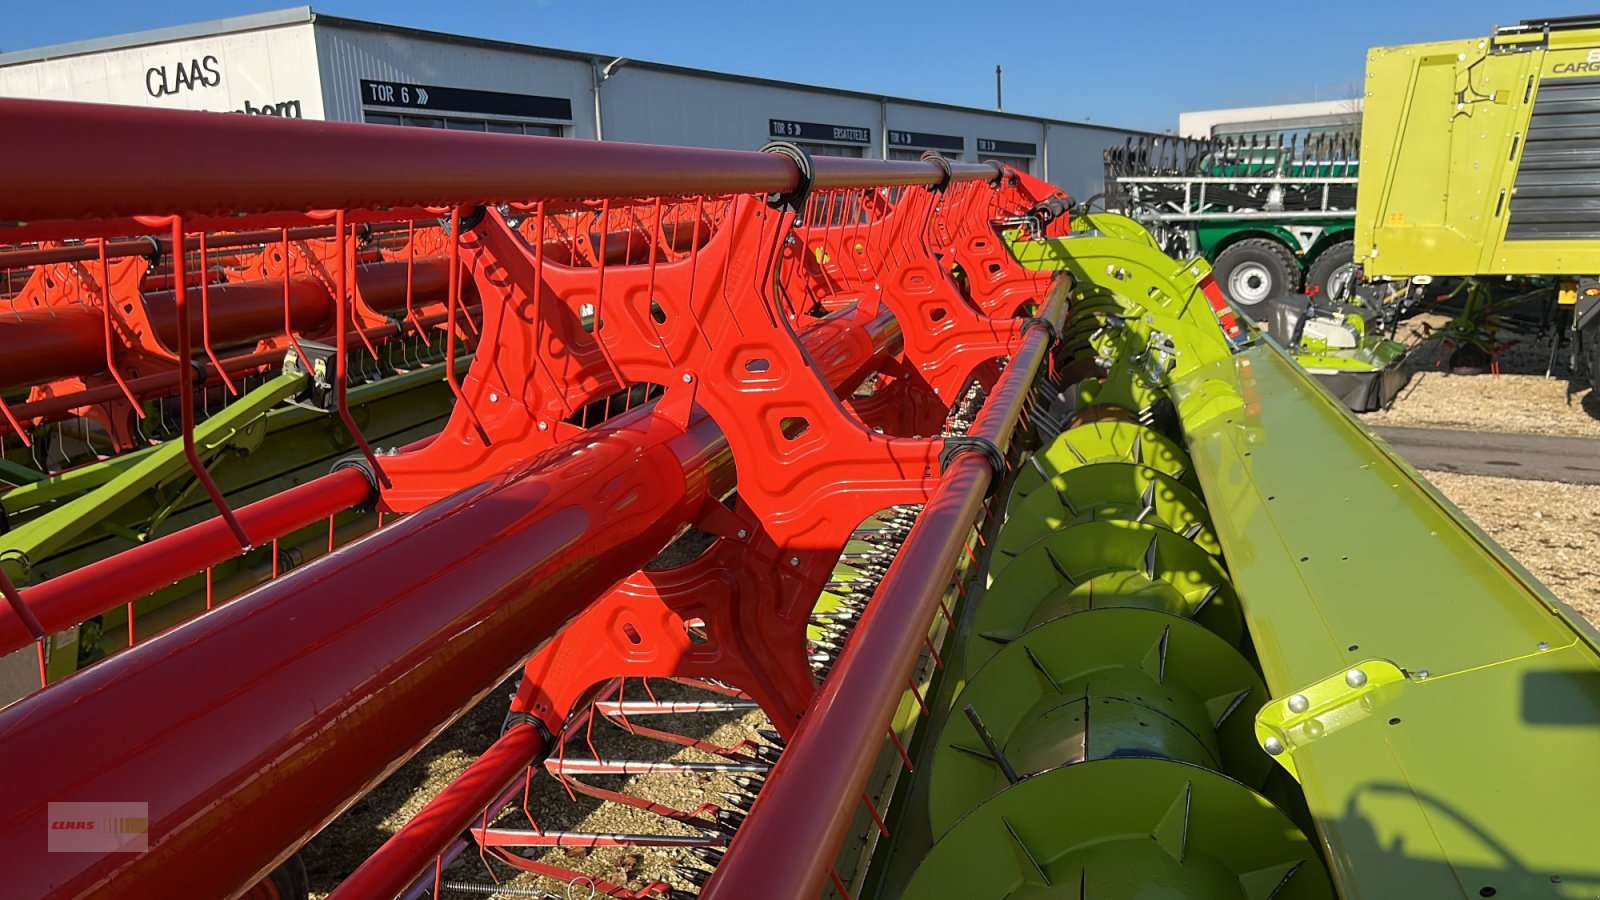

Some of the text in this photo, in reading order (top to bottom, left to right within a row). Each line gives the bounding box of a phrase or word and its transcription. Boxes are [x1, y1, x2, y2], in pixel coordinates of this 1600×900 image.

[145, 55, 221, 98] CLAAS
[369, 83, 409, 104] TOR 6
[773, 121, 793, 135] TOR 5
